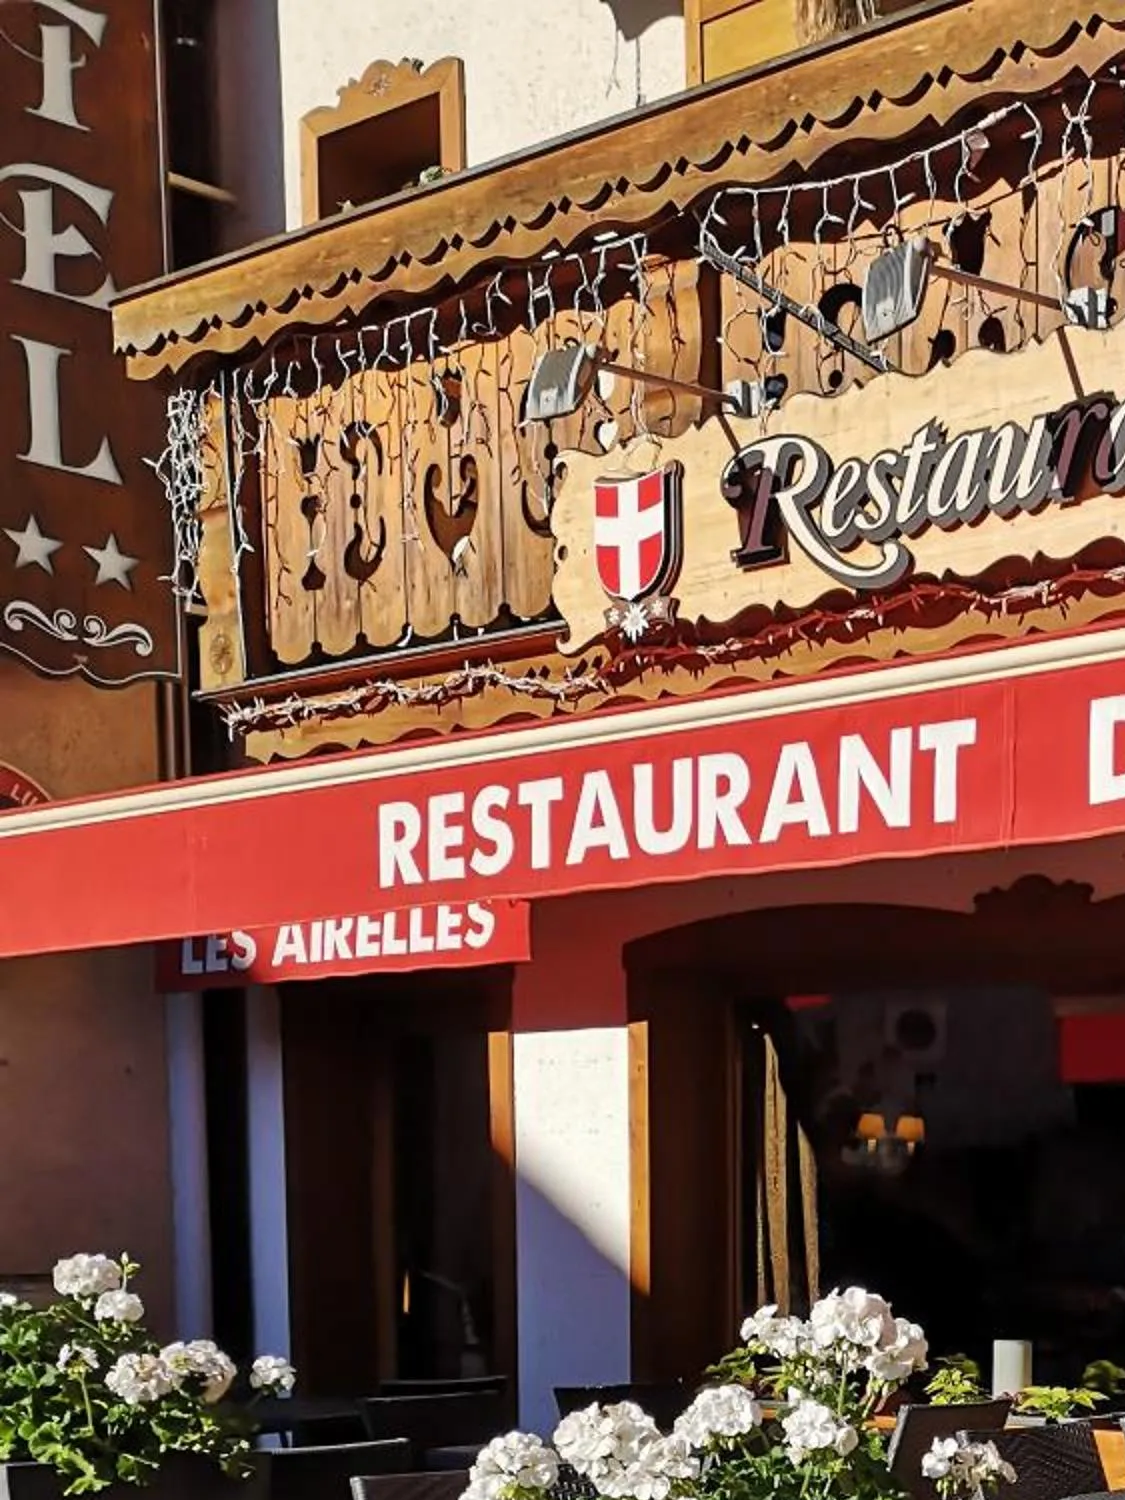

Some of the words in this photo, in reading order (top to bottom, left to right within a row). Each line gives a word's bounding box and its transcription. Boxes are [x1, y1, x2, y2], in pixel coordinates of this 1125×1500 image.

[378, 718, 977, 889] RESTAURANT
[181, 929, 257, 975] LES
[271, 900, 496, 967] AIRELLES
